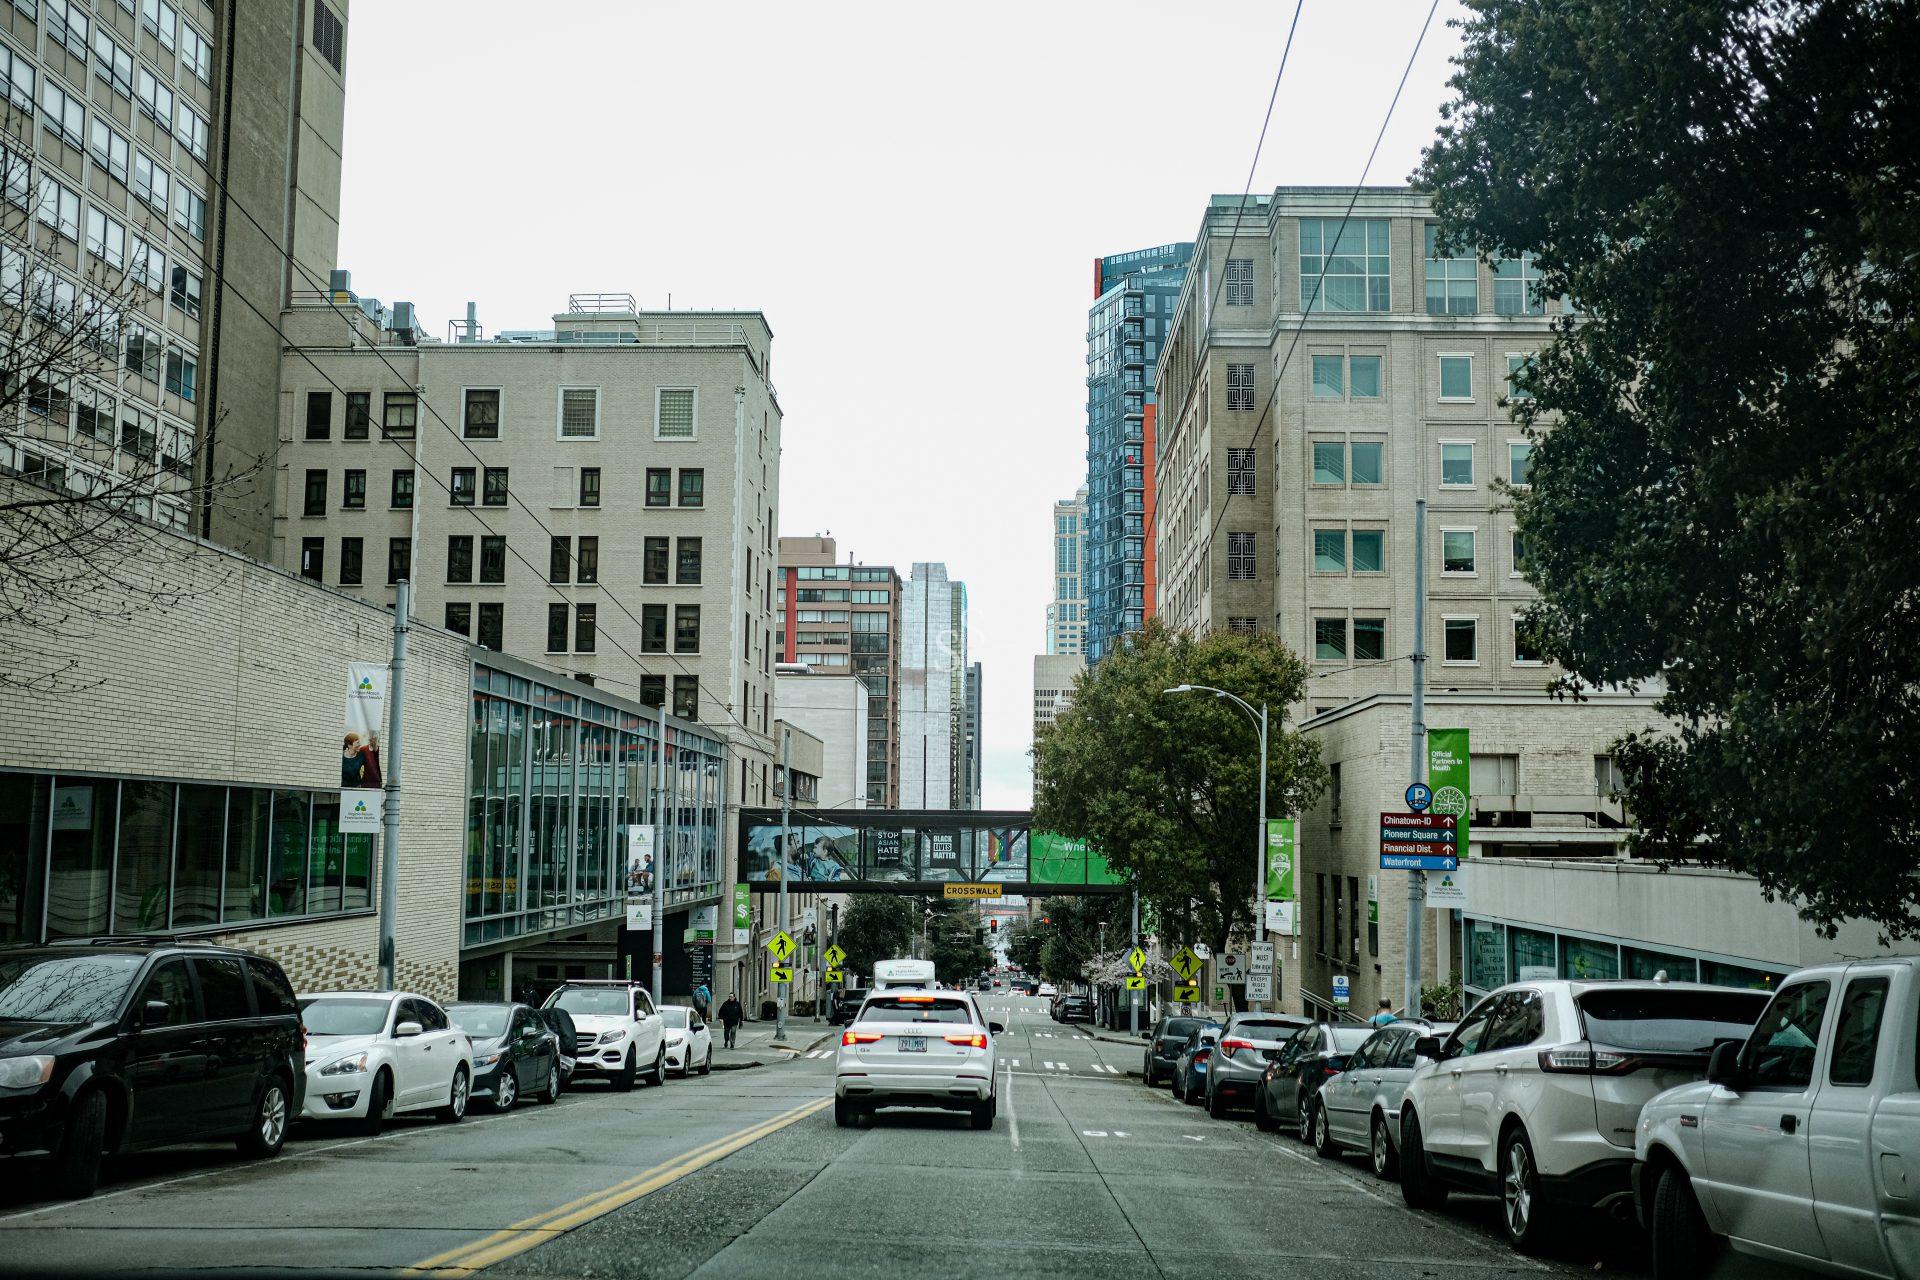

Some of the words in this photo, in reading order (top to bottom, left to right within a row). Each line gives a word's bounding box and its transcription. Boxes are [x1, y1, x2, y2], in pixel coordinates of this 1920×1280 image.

[1414, 788, 1425, 800] P
[1384, 816, 1432, 825] Chinatown-ID
[1384, 830, 1410, 838] Pioneer
[1412, 831, 1438, 840] Square
[1384, 844, 1415, 853] Financial
[1417, 845, 1433, 853] Dist.
[1384, 858, 1421, 867] Waterfront
[946, 887, 998, 895] CROSSWALK
